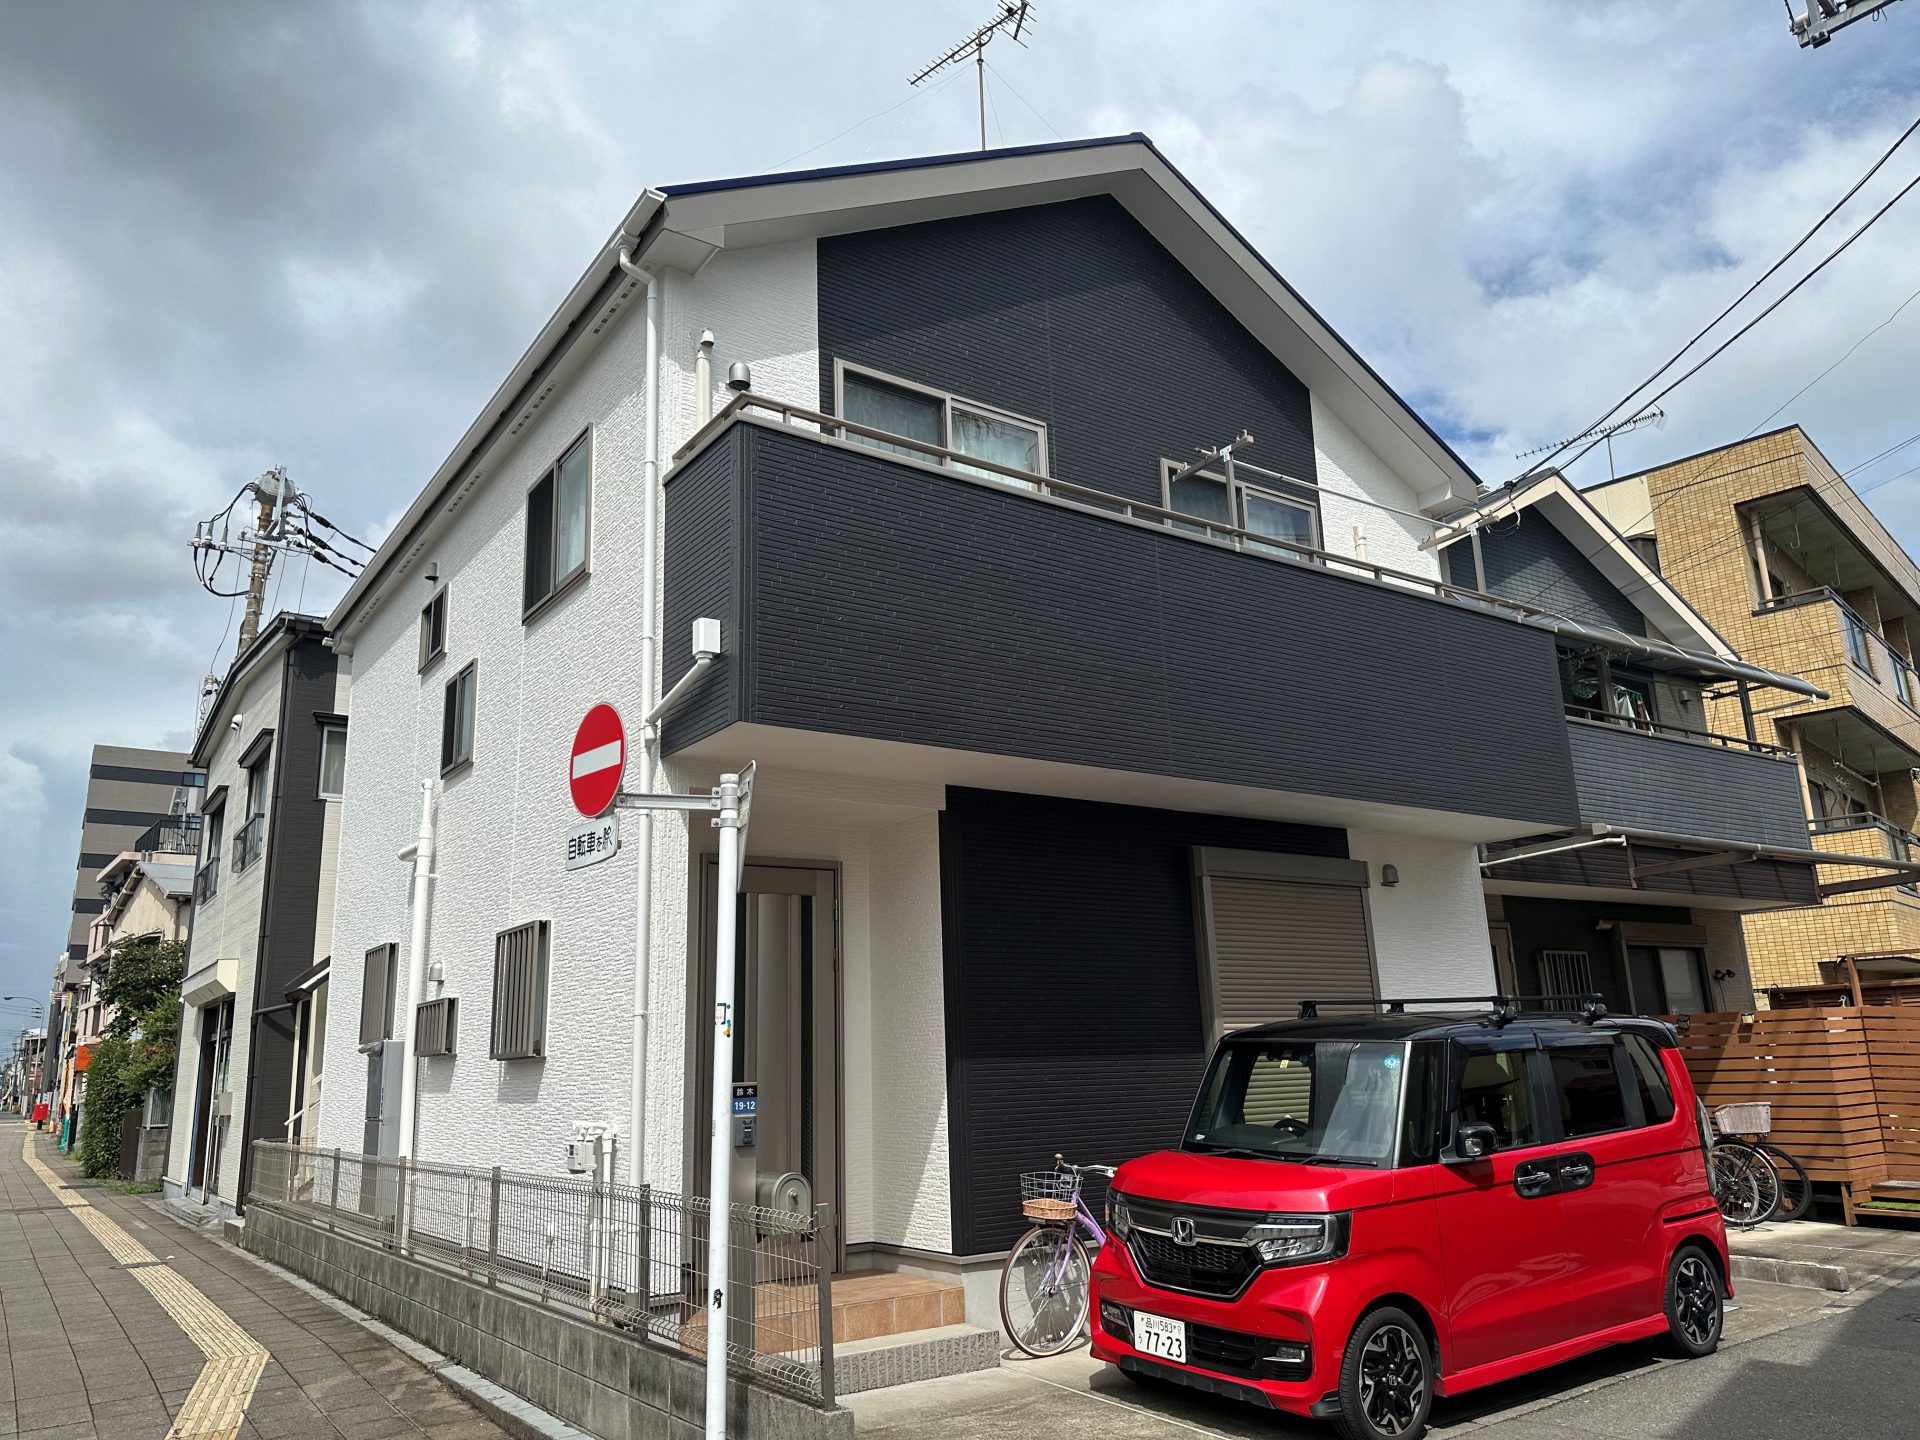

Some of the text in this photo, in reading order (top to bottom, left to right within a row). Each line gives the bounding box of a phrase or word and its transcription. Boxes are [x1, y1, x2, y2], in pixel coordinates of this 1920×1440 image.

[736, 1087, 754, 1097] 鈴木
[734, 1101, 756, 1111] 19-12
[1145, 1330, 1182, 1359] 77-23
